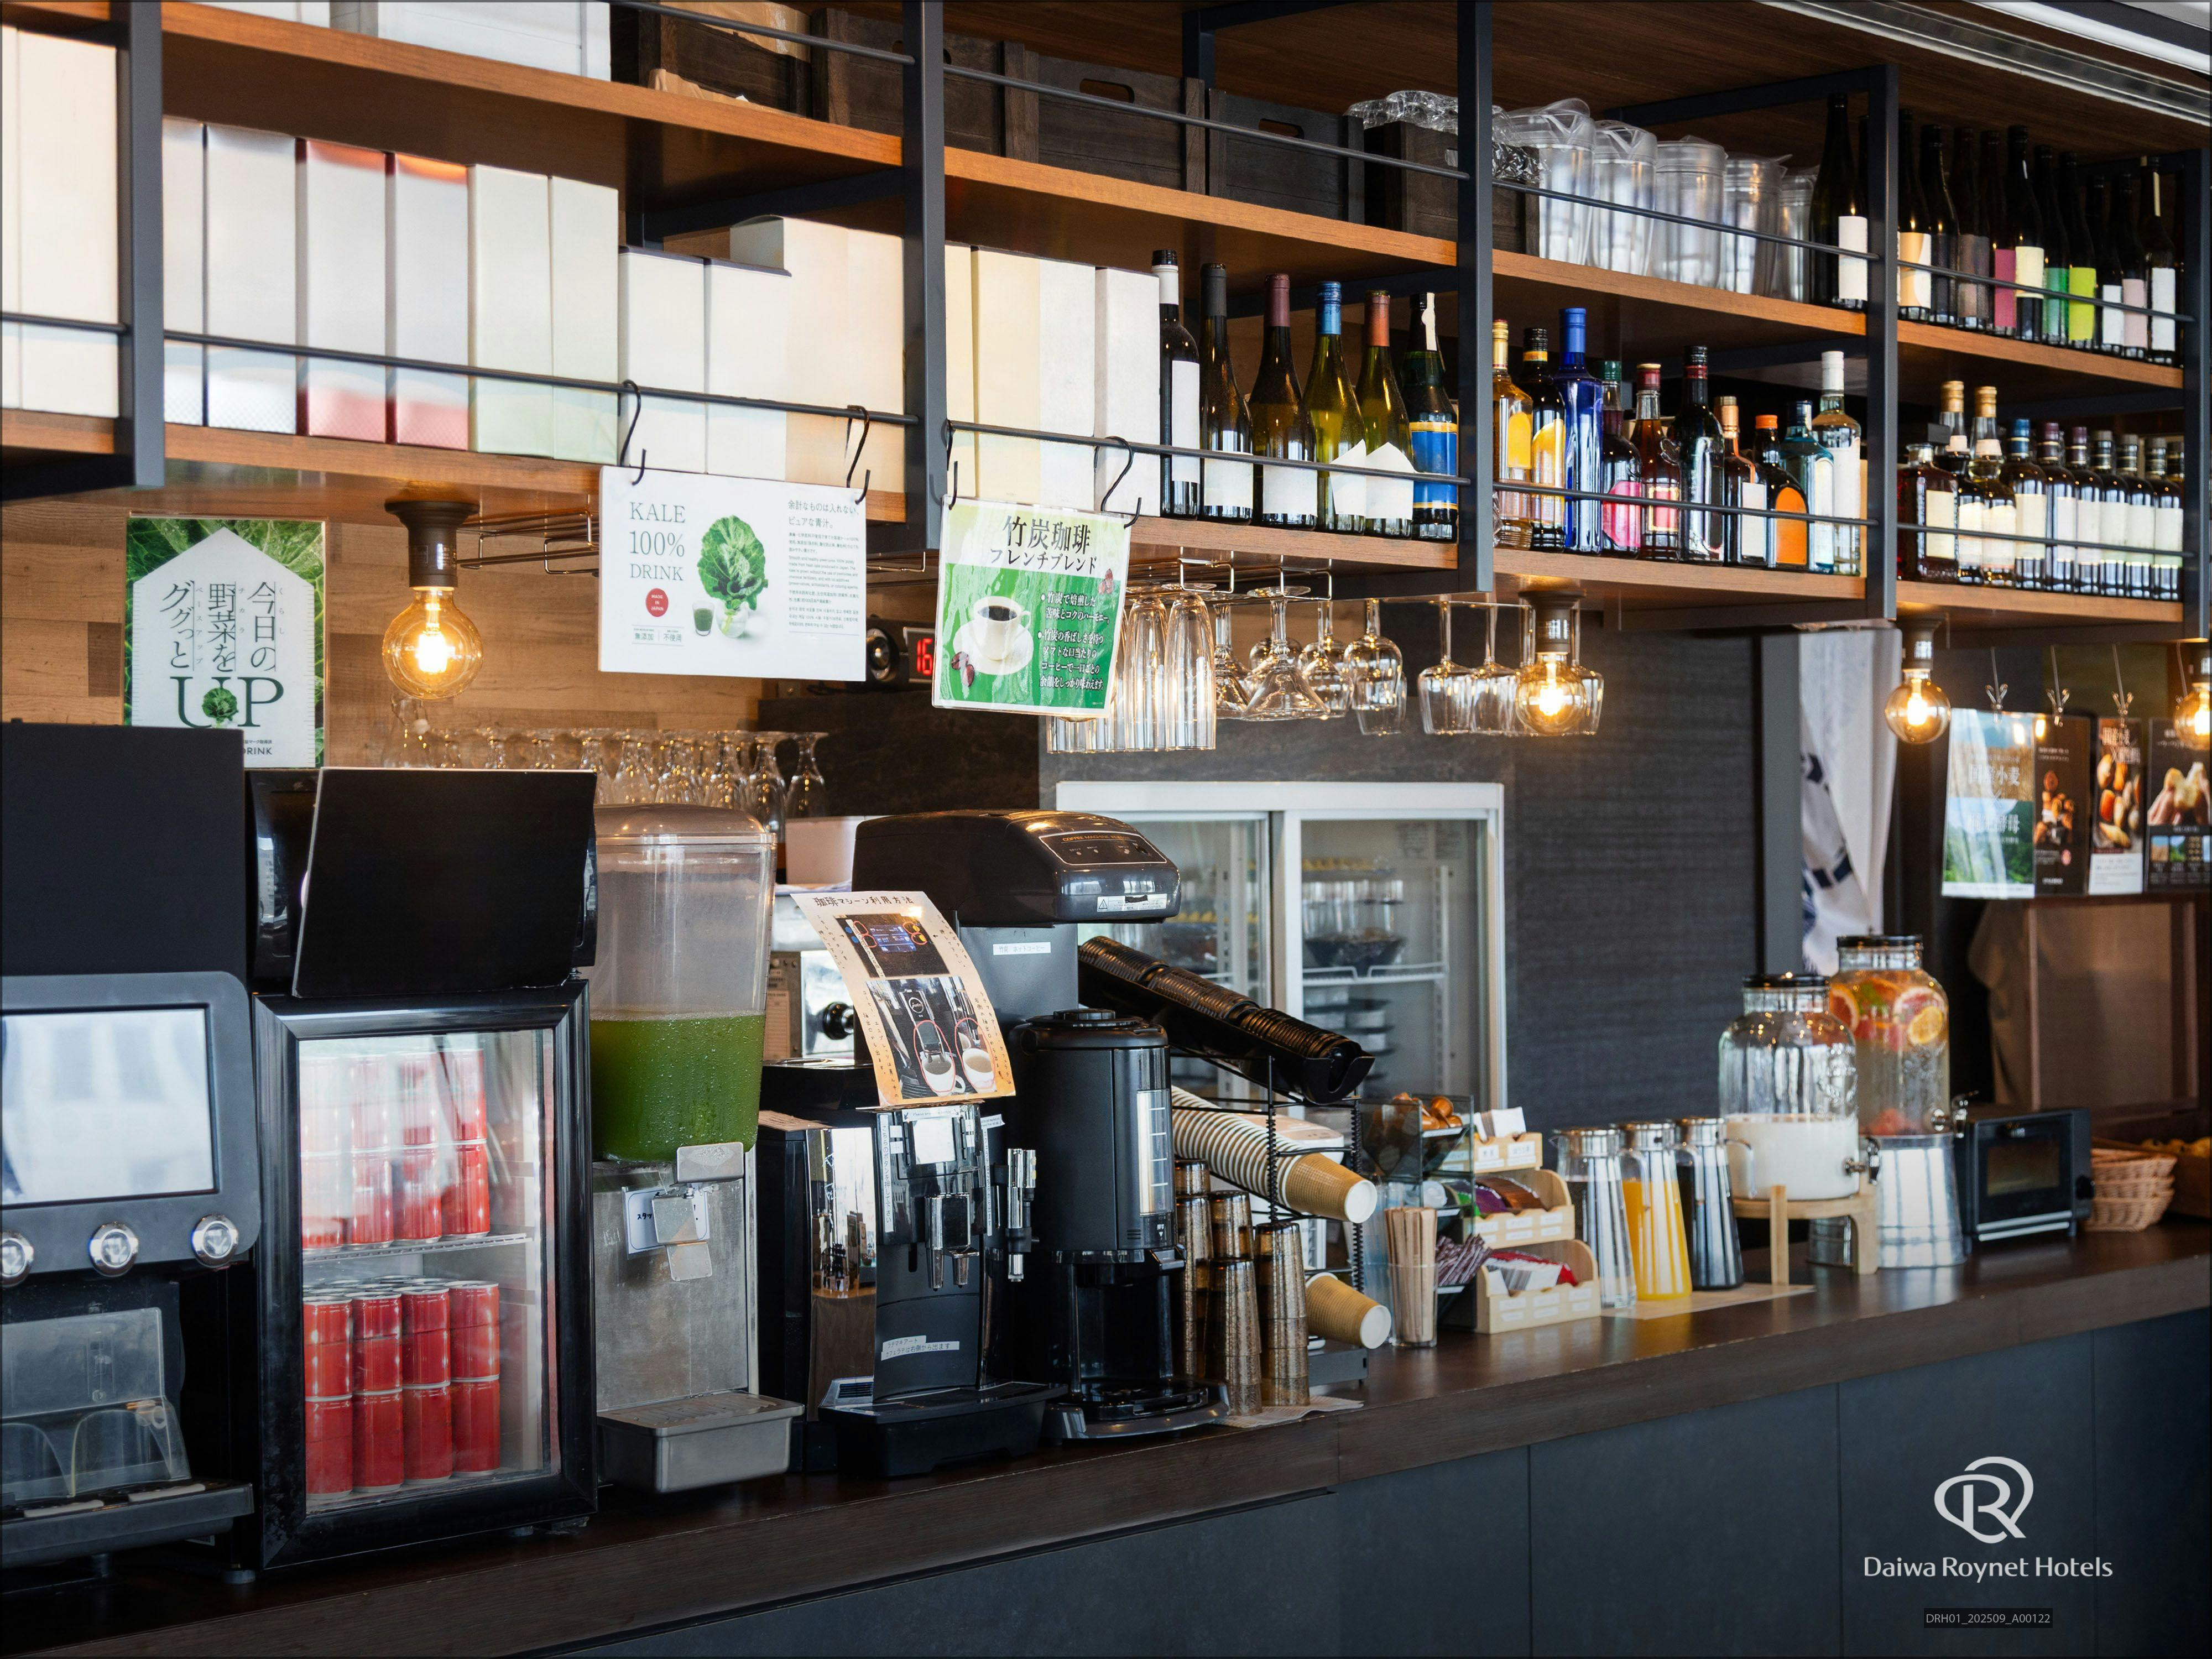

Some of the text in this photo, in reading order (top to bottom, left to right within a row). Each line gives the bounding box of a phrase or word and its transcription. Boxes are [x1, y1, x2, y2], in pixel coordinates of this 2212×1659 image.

[629, 501, 686, 523] KALE
[629, 530, 685, 557] 100%
[1003, 515, 1091, 555] 竹炭珈琲
[990, 549, 1097, 575] フレンチブレンド
[630, 564, 684, 581] DRINK
[1047, 591, 1096, 607] 竹炭で焙煎した
[1046, 607, 1110, 624] 苦味とコクのハーモニー。
[160, 580, 195, 669] ググっと
[208, 582, 236, 672] 野菜を
[247, 582, 276, 671] 今日の
[664, 633, 682, 641] 不使用
[1044, 628, 1104, 645] 竹炭の香ばしさを持つ
[1043, 645, 1097, 659] ソフトな口当たりの
[1041, 662, 1100, 675] コーヒーで一口ごとの
[1040, 676, 1104, 691] 余韻をしっかり味わえます。
[170, 676, 284, 728] UP
[813, 896, 914, 907] 珈琲マシーン利用方法
